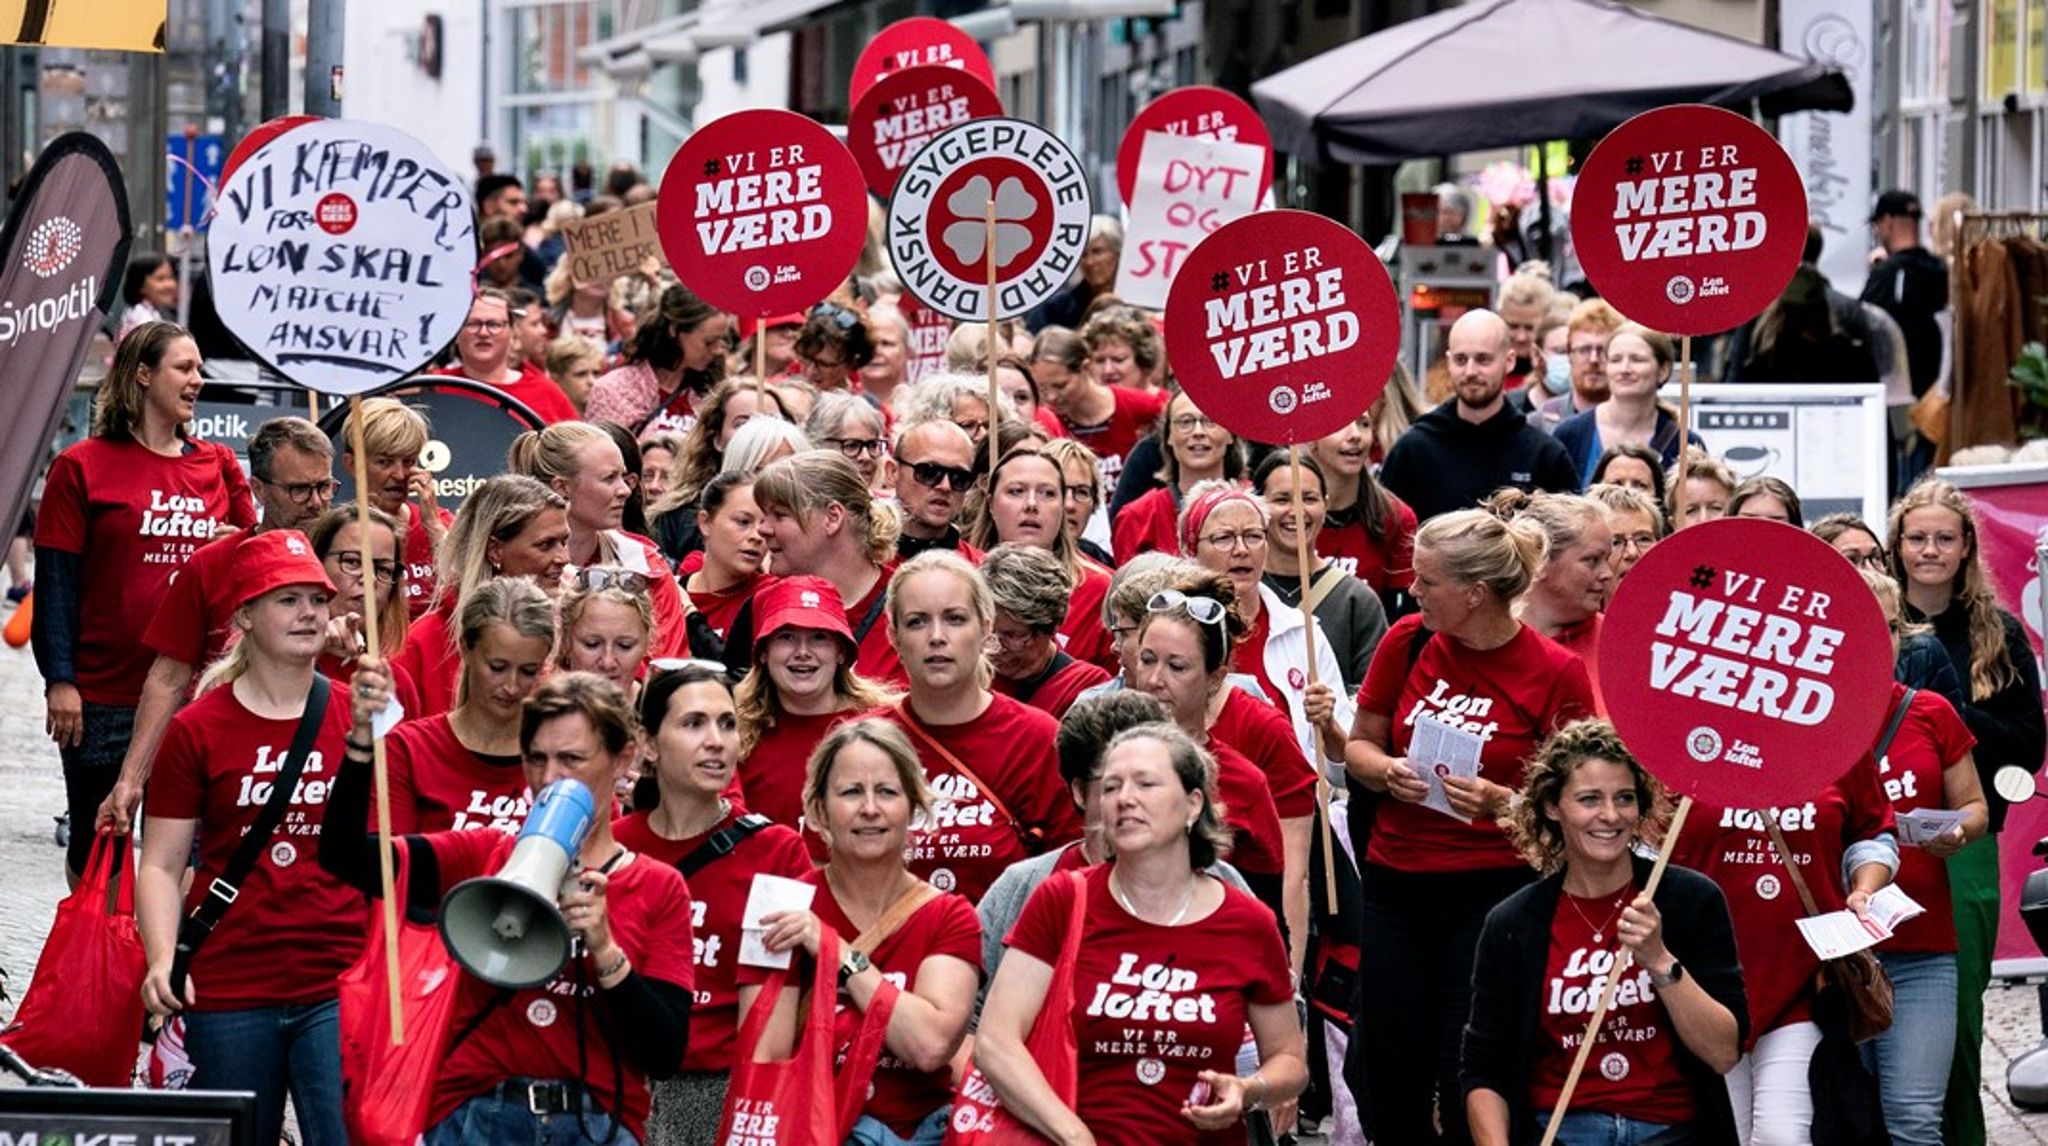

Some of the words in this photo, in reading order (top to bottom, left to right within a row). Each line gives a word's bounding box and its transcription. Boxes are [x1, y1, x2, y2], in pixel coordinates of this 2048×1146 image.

[927, 43, 953, 63] ER
[927, 84, 955, 104] ER
[873, 96, 971, 146] MERE
[1197, 111, 1225, 132] ER
[769, 145, 805, 167] ER
[905, 126, 1084, 205] SYGEPLEJE
[1700, 145, 1739, 168] ER
[694, 165, 823, 218] MERE
[1163, 160, 1250, 199] DYT
[1613, 168, 1758, 219] MERE
[696, 204, 833, 256] VÆRD
[1166, 202, 1222, 235] OG
[565, 219, 623, 253] MERE
[1615, 211, 1767, 262] VÆRD
[222, 240, 310, 276] LØN
[316, 243, 443, 287] SKAL
[895, 214, 980, 315] DANSK
[1001, 222, 1084, 312] RAAD
[1129, 240, 1187, 279] ST
[1284, 247, 1323, 275] ER
[1205, 268, 1346, 339] MERE
[1210, 311, 1360, 379] VÆRD
[143, 553, 178, 563] MERE
[162, 543, 176, 552] VI
[180, 543, 195, 553] ER
[1778, 585, 1831, 619] ER
[1655, 591, 1845, 676] MERE
[1650, 641, 1836, 726] VÆRD
[286, 812, 305, 823] ER
[289, 823, 322, 836] VÆR
[903, 846, 935, 862] ERE
[943, 845, 991, 858] VÆRD
[915, 834, 932, 845] VI
[940, 833, 960, 845] ER
[1747, 839, 1761, 850] VI
[1724, 851, 1765, 864] MERE
[1770, 853, 1811, 865] VRD
[1123, 1028, 1145, 1041] VI
[1154, 1030, 1178, 1044] ER
[1608, 1015, 1628, 1030] ER
[1095, 1041, 1147, 1055] MERE
[1157, 1044, 1213, 1059] VÆRD
[731, 1111, 780, 1138] ERE
